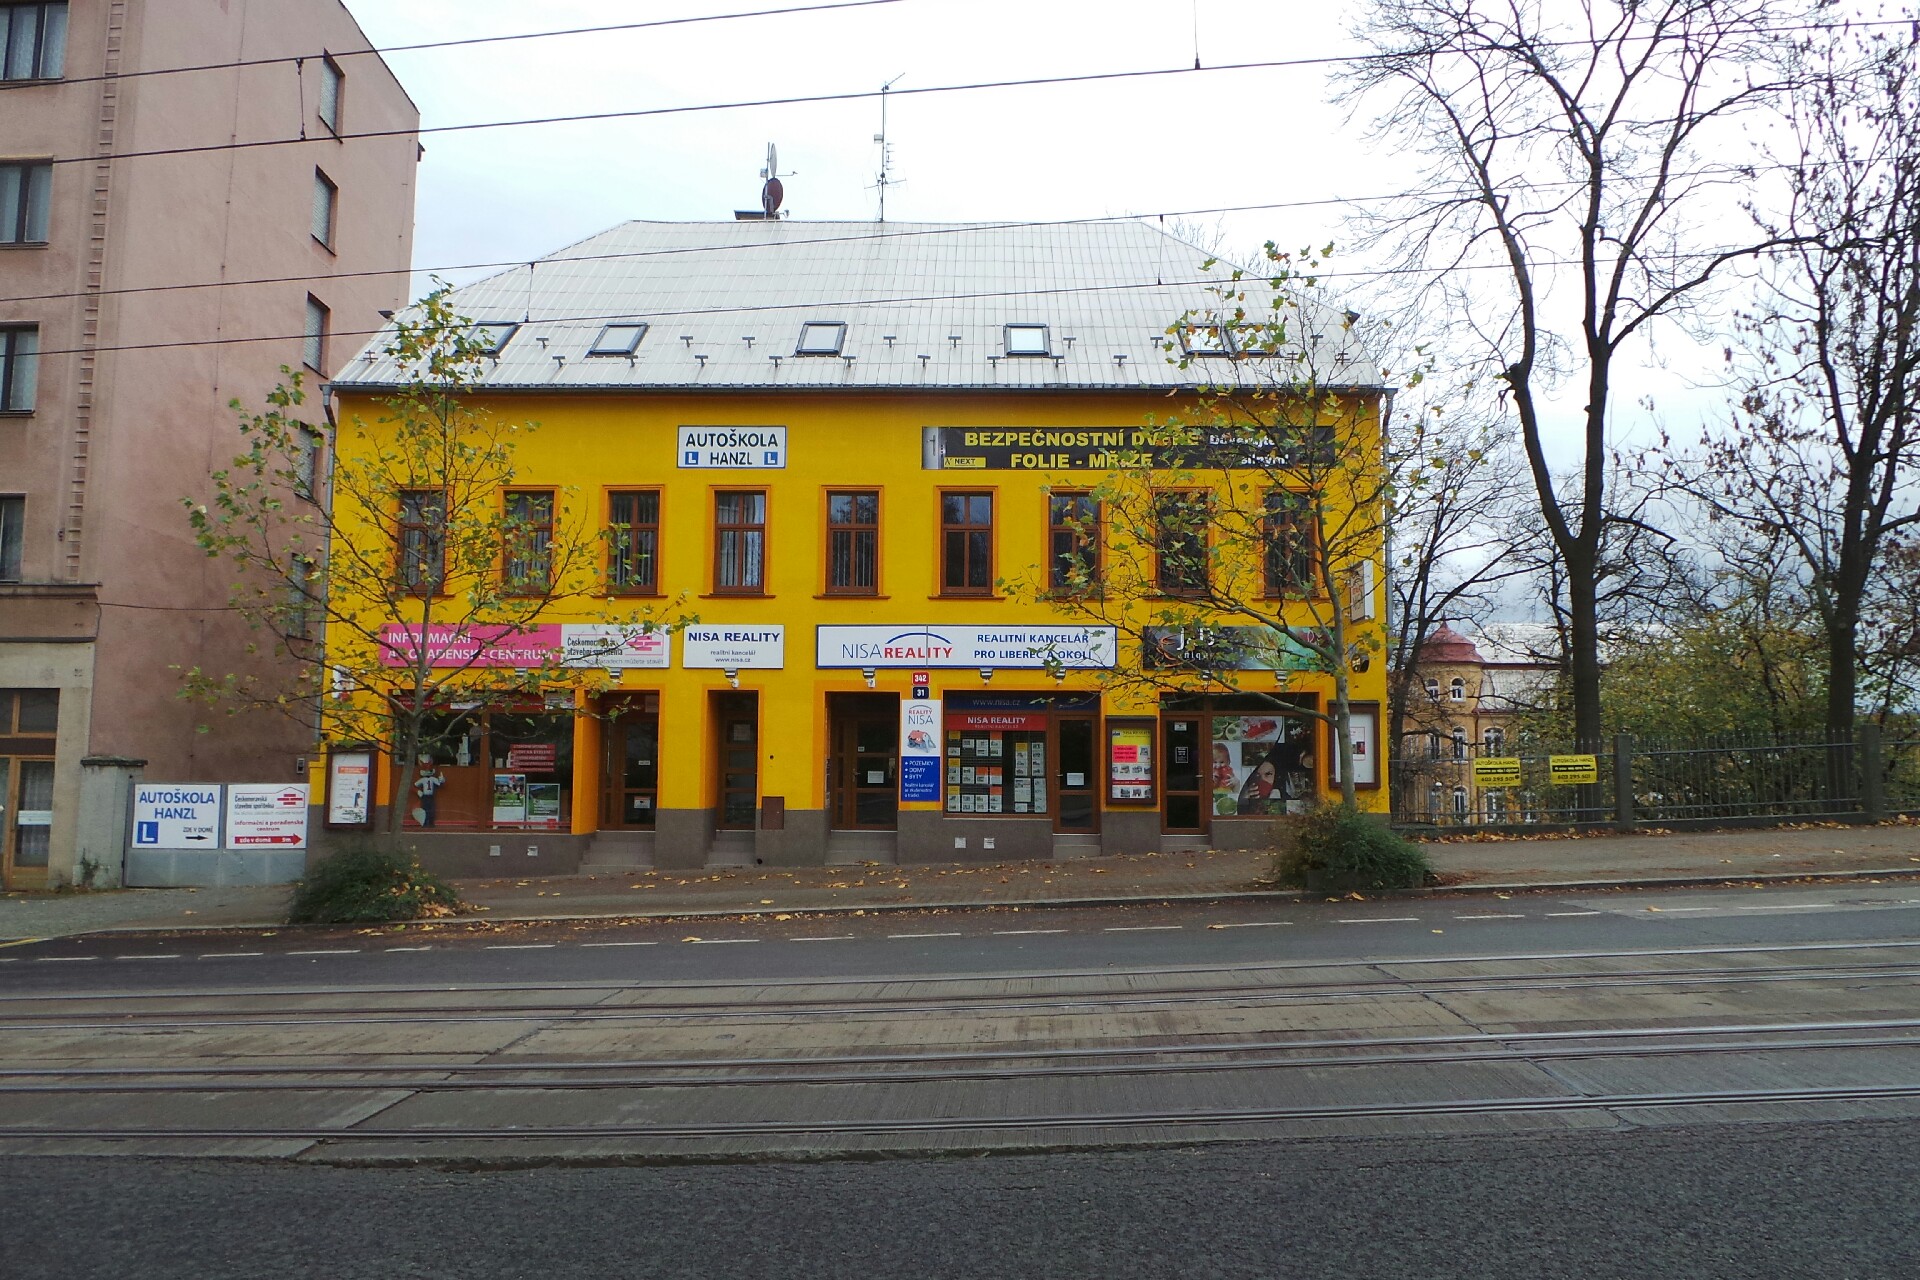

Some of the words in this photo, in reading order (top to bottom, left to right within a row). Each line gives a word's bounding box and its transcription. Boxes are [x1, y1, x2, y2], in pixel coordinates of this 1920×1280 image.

[686, 428, 778, 447] AUTOŠKOLA
[964, 429, 1124, 447] BEZPEČNOSTNÍ
[710, 452, 752, 465] HANZL
[1010, 453, 1070, 468] FOLIE
[688, 632, 720, 642] NISA
[724, 632, 780, 642] REALITY
[977, 632, 1026, 643] REALITNÍ
[1029, 632, 1089, 643] KANCELÁŘ
[489, 649, 553, 660] CENTRUM
[842, 643, 882, 659] NISA
[884, 647, 953, 659] REALITY
[974, 650, 996, 659] PRO
[999, 650, 1044, 659] LIBEREC
[1046, 650, 1056, 659] A
[916, 689, 925, 697] 31
[908, 715, 934, 725] NISA
[967, 716, 989, 724] NISA
[990, 716, 1026, 724] REALITY
[139, 788, 215, 804] AUTOŠKOLA
[154, 807, 197, 820] HANZL
